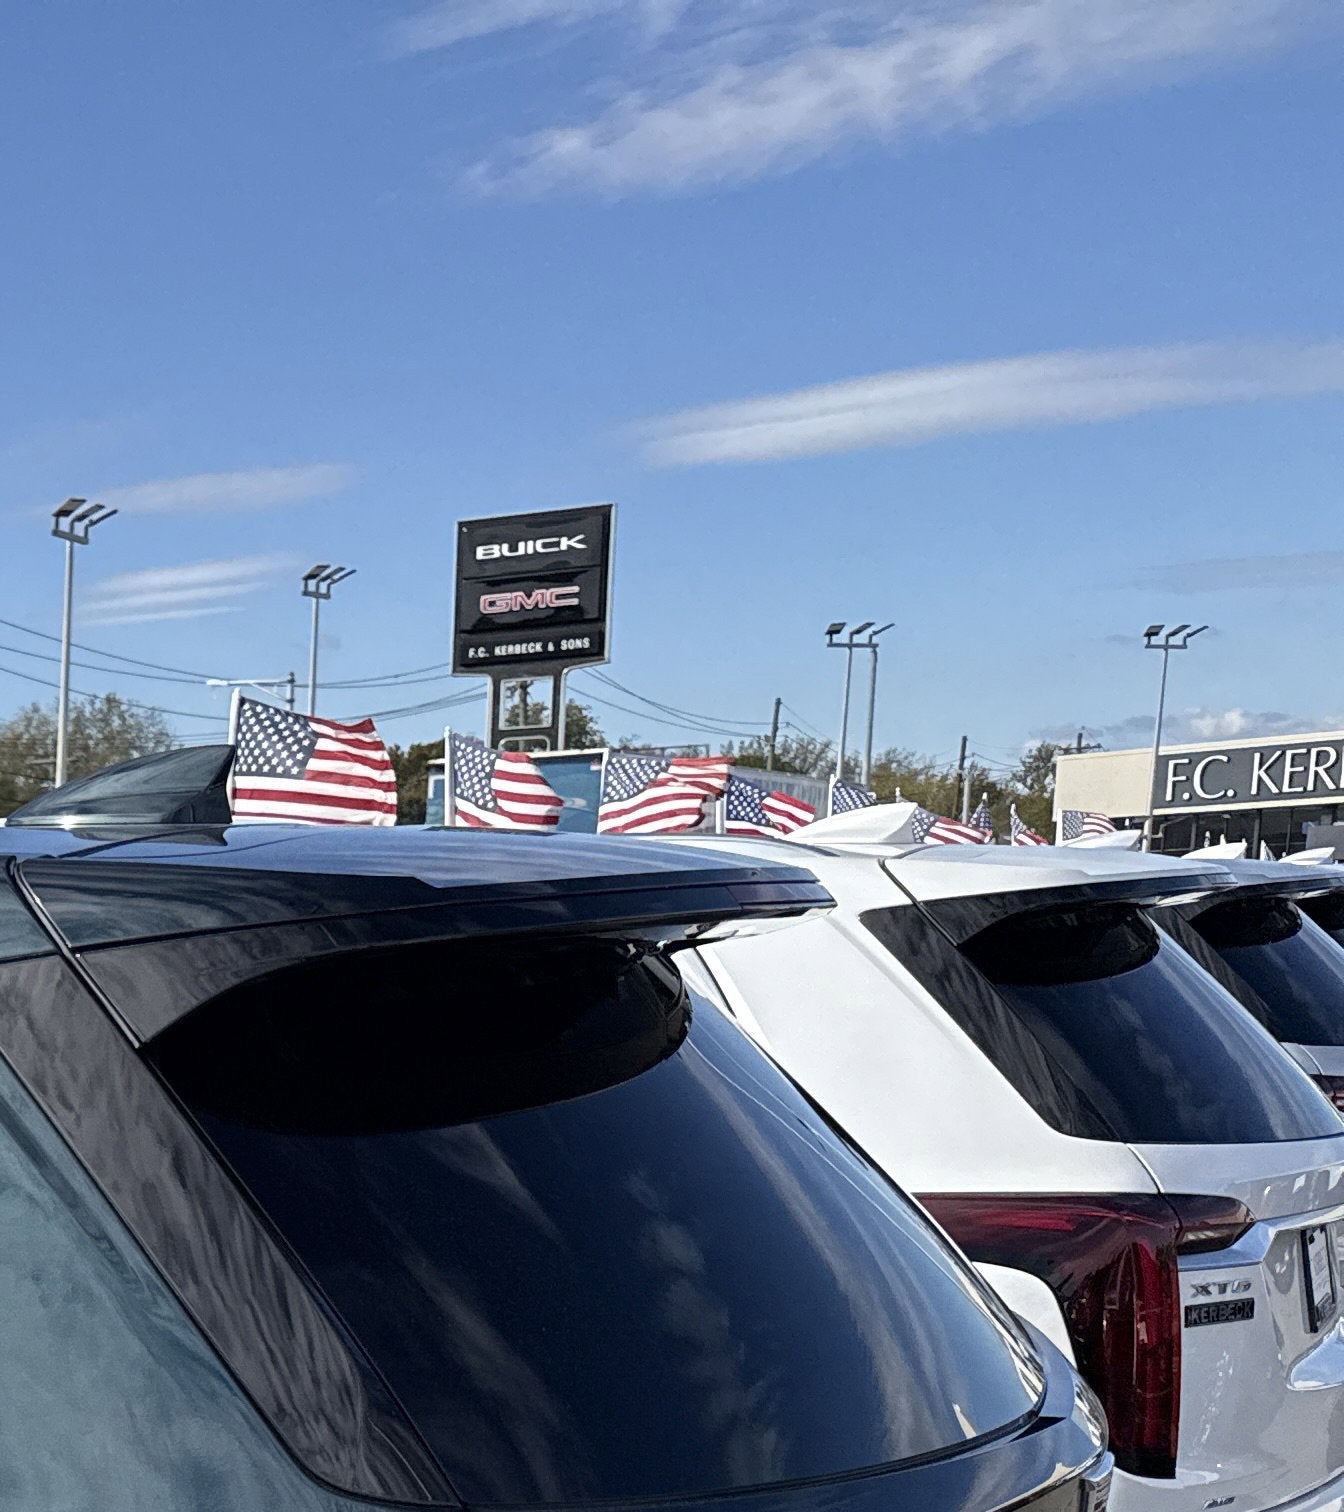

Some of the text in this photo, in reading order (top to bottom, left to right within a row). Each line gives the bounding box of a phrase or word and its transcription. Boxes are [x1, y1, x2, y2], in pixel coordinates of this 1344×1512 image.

[475, 534, 587, 560] BUICK
[479, 586, 580, 614] GMC
[494, 641, 543, 656] KERBECK
[560, 637, 591, 651] SONS
[1166, 745, 1344, 801] F.C. KER
[1190, 1301, 1253, 1324] KERBECK
